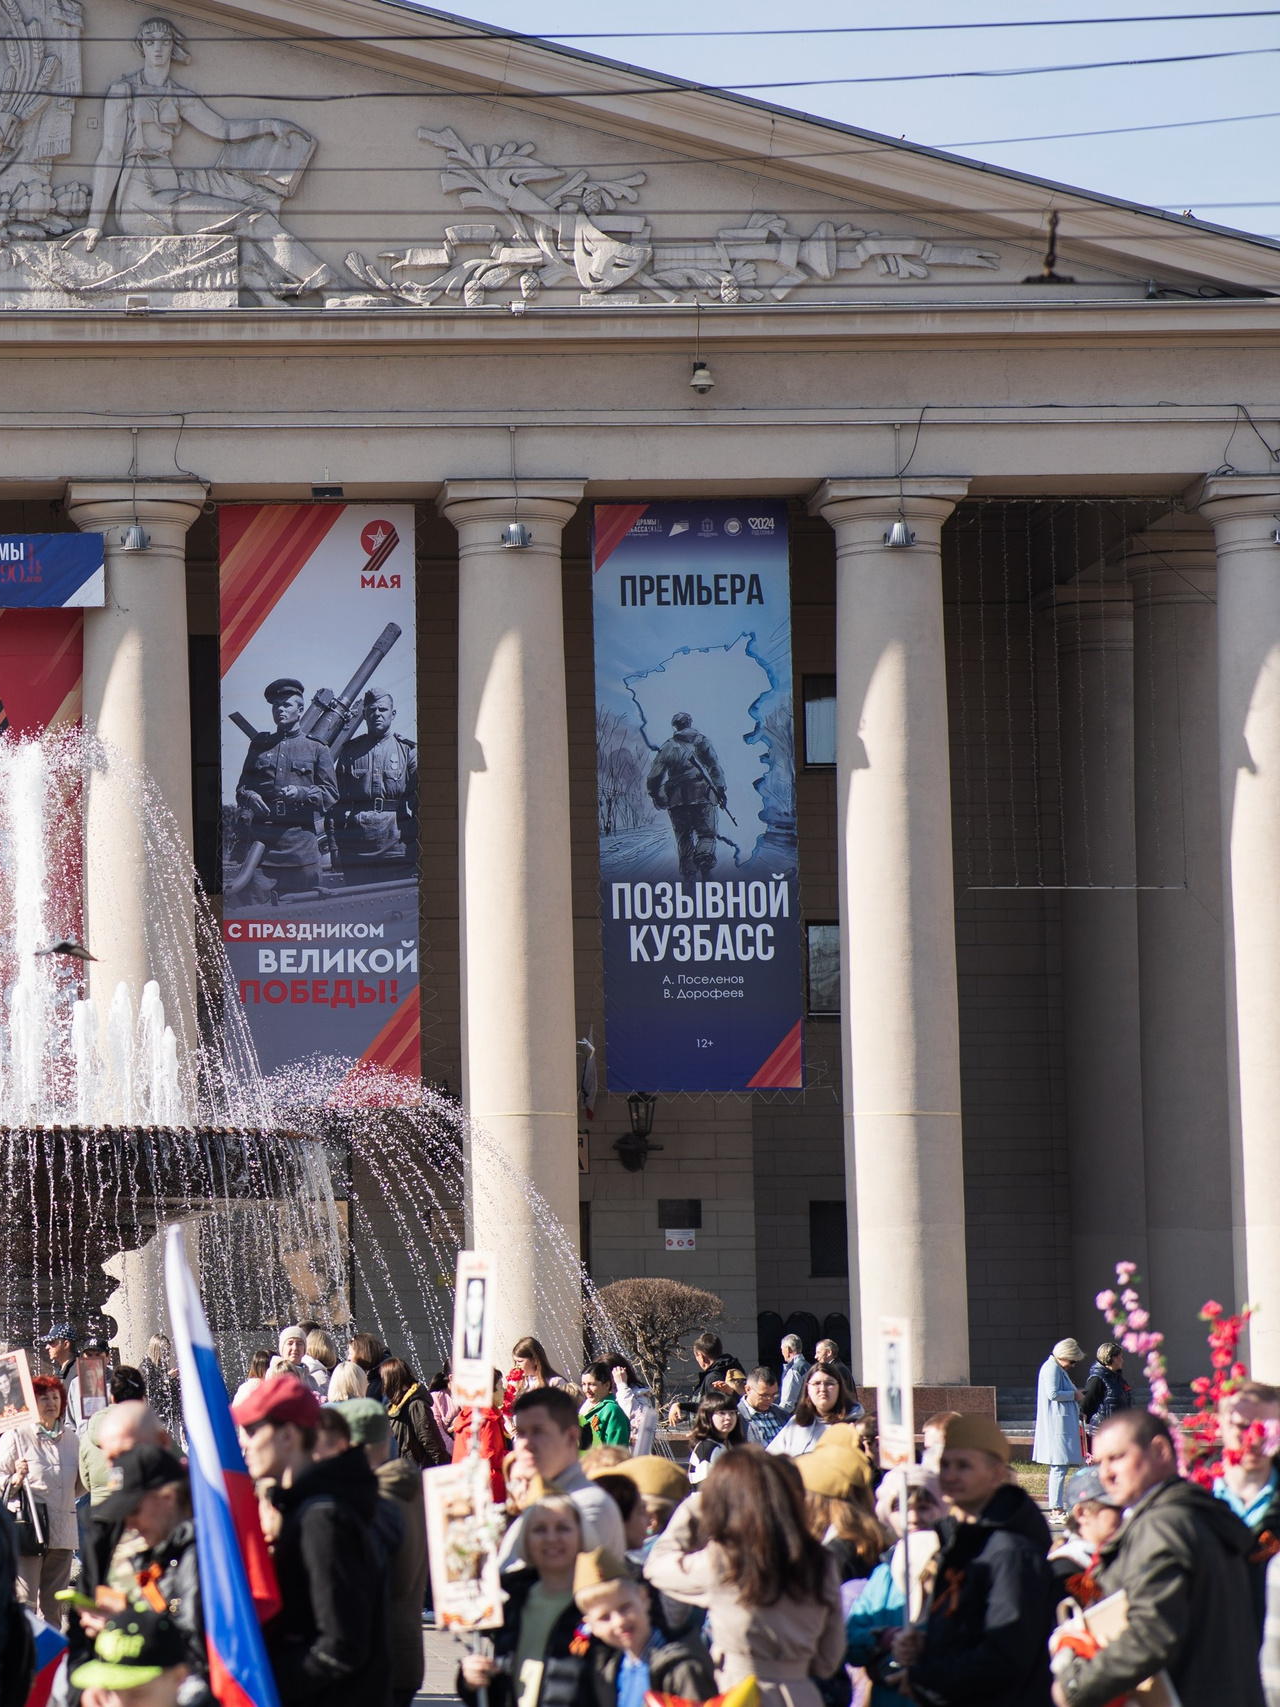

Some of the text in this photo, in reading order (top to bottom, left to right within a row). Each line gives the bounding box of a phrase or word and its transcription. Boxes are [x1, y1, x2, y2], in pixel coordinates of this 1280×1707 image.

[753, 517, 775, 530] 2024
[360, 574, 402, 589] МАЯ
[620, 573, 764, 607] ПРЕМЬЕРА
[611, 873, 789, 920] ПОЗЫВНОЙ
[228, 923, 384, 941] С ПРАЗДНИКОМ
[629, 923, 775, 962] КУЗБАСС
[258, 940, 418, 974] ВЕЛИКОЙ
[662, 974, 745, 985] А. Поселенов
[239, 979, 399, 1009] ПОБЕДЫ!
[663, 988, 744, 1000] В. Дорофеев
[696, 1039, 714, 1048] 12+
